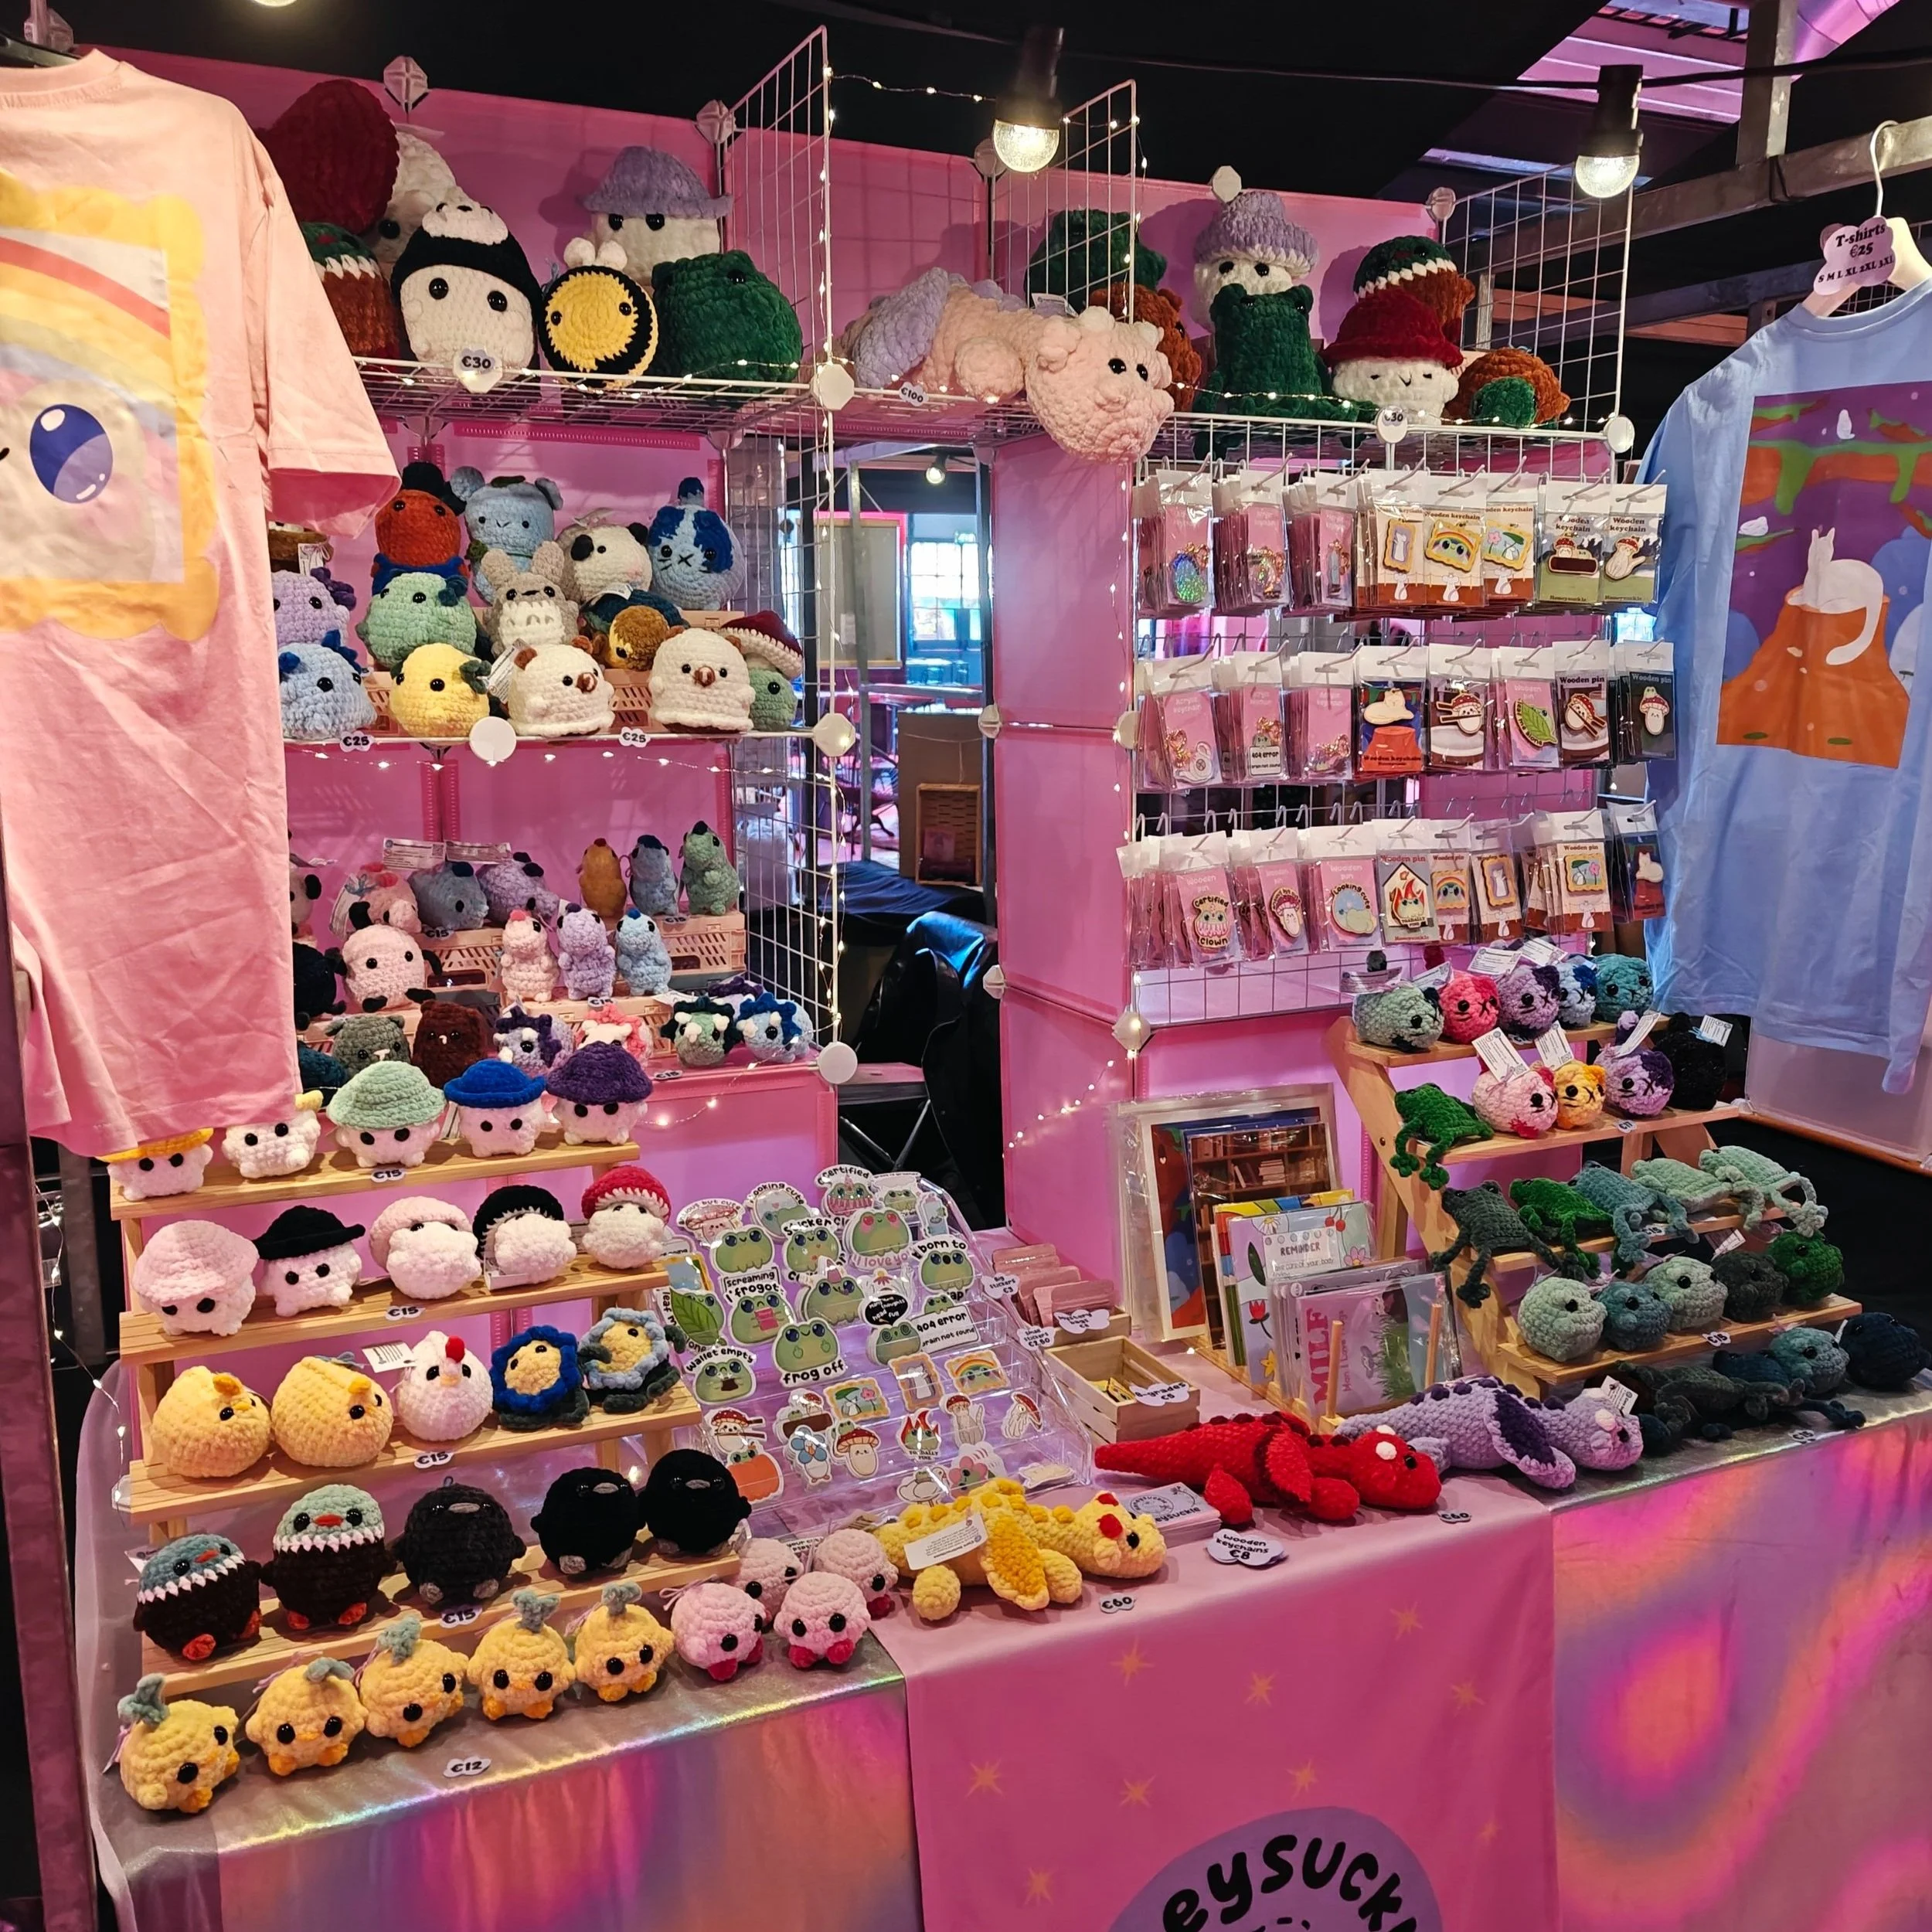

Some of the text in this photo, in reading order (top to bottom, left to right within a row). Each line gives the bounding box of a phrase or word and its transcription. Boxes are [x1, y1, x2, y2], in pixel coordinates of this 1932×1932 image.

[1835, 224, 1886, 247] T-shirts
[1850, 242, 1873, 257] €25
[1827, 272, 1835, 281] M
[1838, 270, 1844, 279] L
[1845, 267, 1858, 277] XL
[1859, 261, 1877, 273] 2XL
[461, 356, 492, 369] €30
[901, 388, 923, 403] €100
[1559, 515, 1590, 524] Woden
[1556, 524, 1590, 532] keychain
[1591, 677, 1605, 685] pin
[1631, 673, 1672, 684] Wooden pin
[342, 736, 369, 747] €25
[622, 733, 646, 743] €25
[1361, 892, 1370, 909] cute
[425, 930, 449, 938] €15
[373, 1169, 402, 1179] €15
[749, 1182, 804, 1205] ooking cute
[783, 1217, 832, 1236] Scker
[918, 1239, 966, 1253] born to
[1280, 1241, 1321, 1257] REMINDER
[865, 1257, 892, 1267] love
[726, 1271, 775, 1287] screaming
[388, 1307, 419, 1316] €15
[662, 1292, 672, 1312] leaf
[668, 1315, 677, 1325] m
[917, 1313, 967, 1332] 404 error
[940, 1332, 954, 1340] not
[1707, 1333, 1728, 1343] €15
[721, 1348, 753, 1363] empty
[1306, 1308, 1330, 1404] MILF
[783, 1360, 845, 1384] frog off
[417, 1451, 449, 1464] €15
[1216, 1538, 1269, 1554] keychains
[1223, 1534, 1267, 1546] wooden
[1230, 1549, 1250, 1560] €8
[1102, 1597, 1133, 1609] €60
[442, 1608, 476, 1624] €15
[451, 1761, 483, 1773] €12
